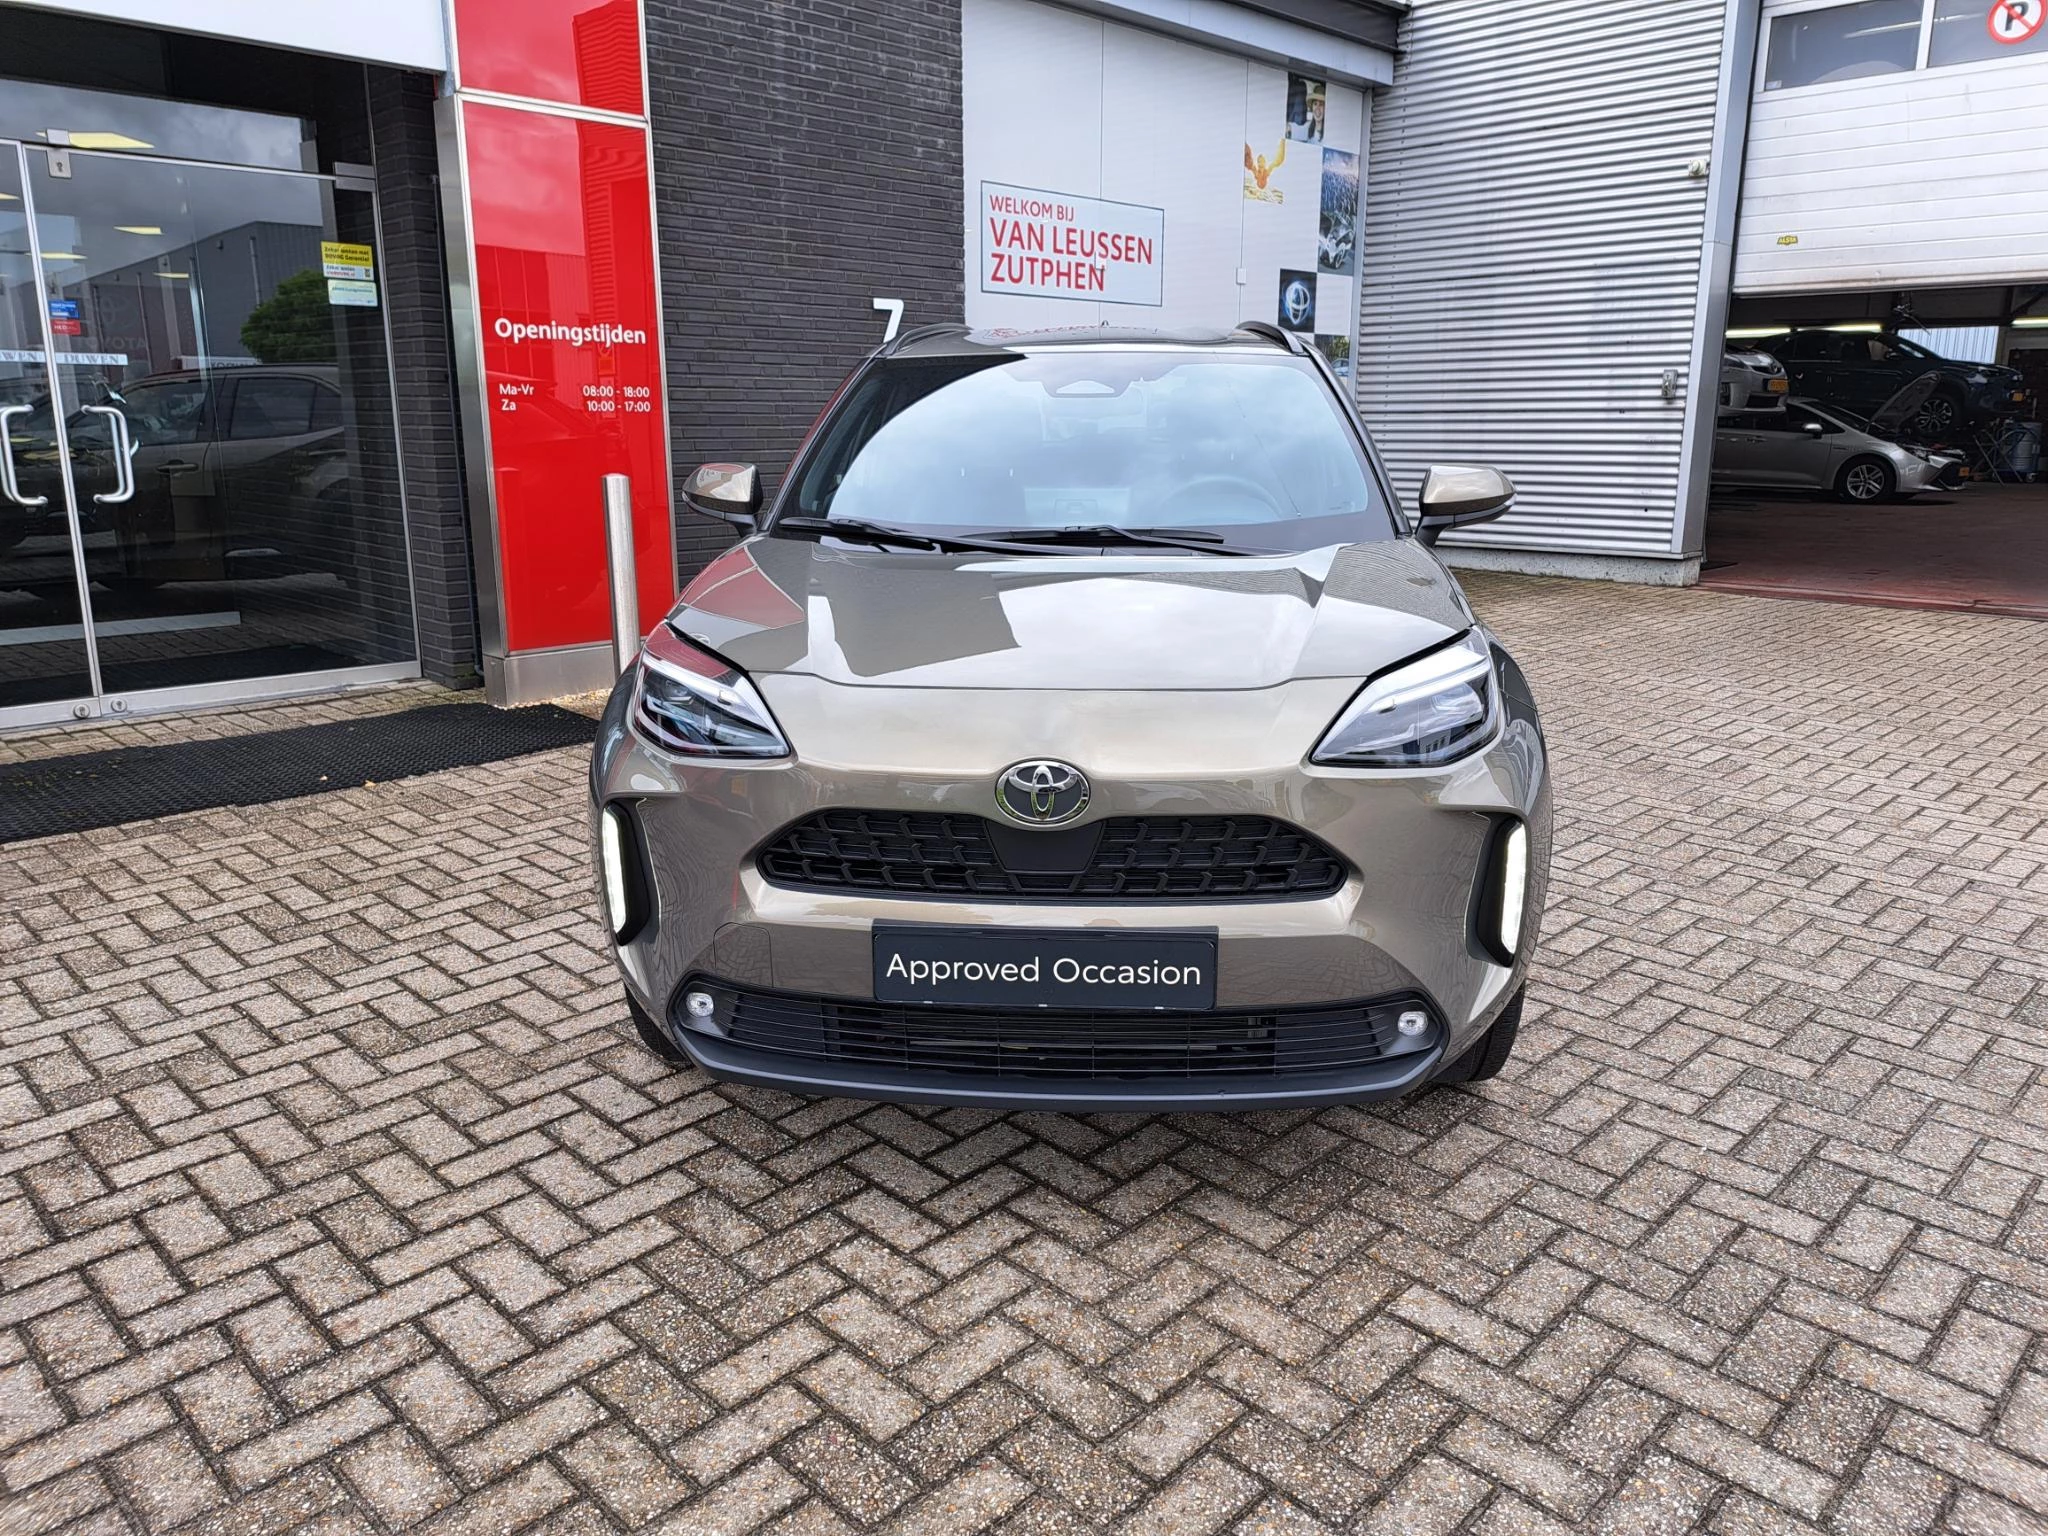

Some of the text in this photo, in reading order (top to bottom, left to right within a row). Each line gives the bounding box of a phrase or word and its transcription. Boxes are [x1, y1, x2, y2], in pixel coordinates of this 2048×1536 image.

[989, 194, 1075, 222] WELKOM BIJ
[989, 217, 1153, 265] VAN LEUSSEN
[990, 253, 1105, 292] ZUTPHEN
[494, 317, 646, 348] Openingstijden
[872, 297, 905, 343] 7
[499, 383, 534, 396] Ma-Vr
[582, 385, 614, 397] 08:00
[623, 386, 650, 398] 18:00
[501, 399, 517, 411] Za
[586, 400, 615, 412] 10:00
[624, 401, 651, 413] 17:00
[885, 952, 1202, 986] Approved Occasion
